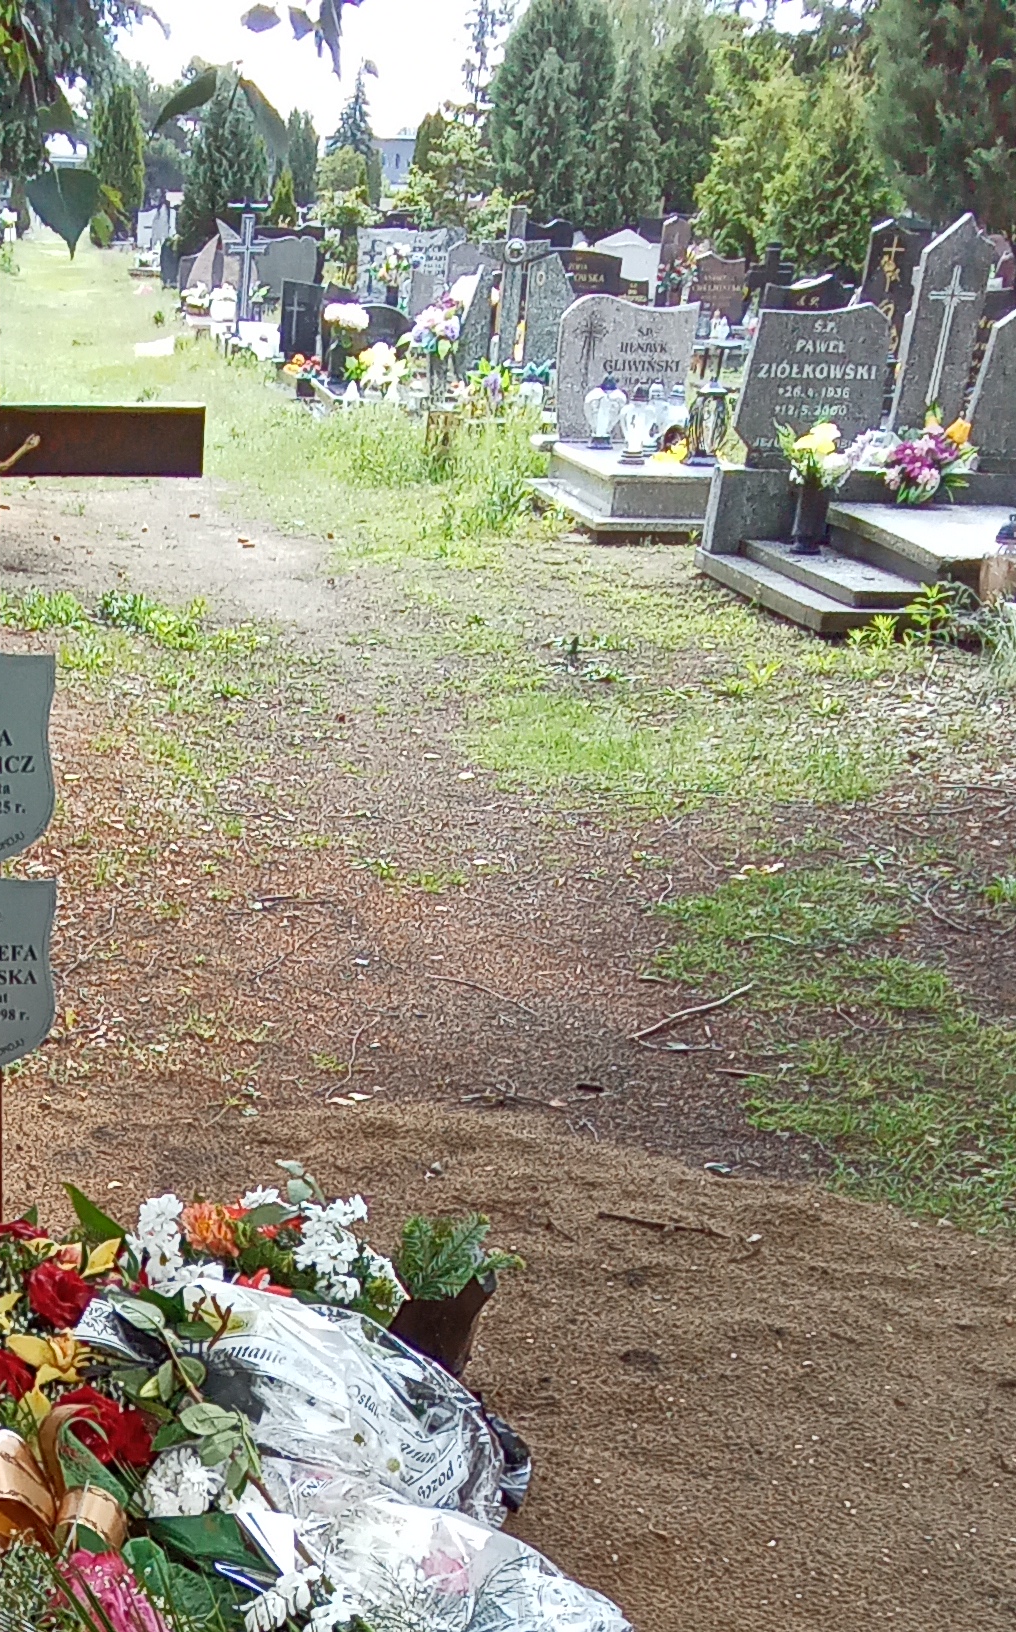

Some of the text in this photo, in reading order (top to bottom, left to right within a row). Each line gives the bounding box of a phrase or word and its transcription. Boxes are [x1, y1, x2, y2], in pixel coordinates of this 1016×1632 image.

[620, 341, 668, 354] HENRYK
[795, 338, 847, 354] PAWEŁ
[602, 357, 681, 373] GLIWIŃSKI
[757, 358, 878, 381] ZIÓŁKOWSKI
[15, 803, 26, 815] r.
[19, 1010, 30, 1021] r.
